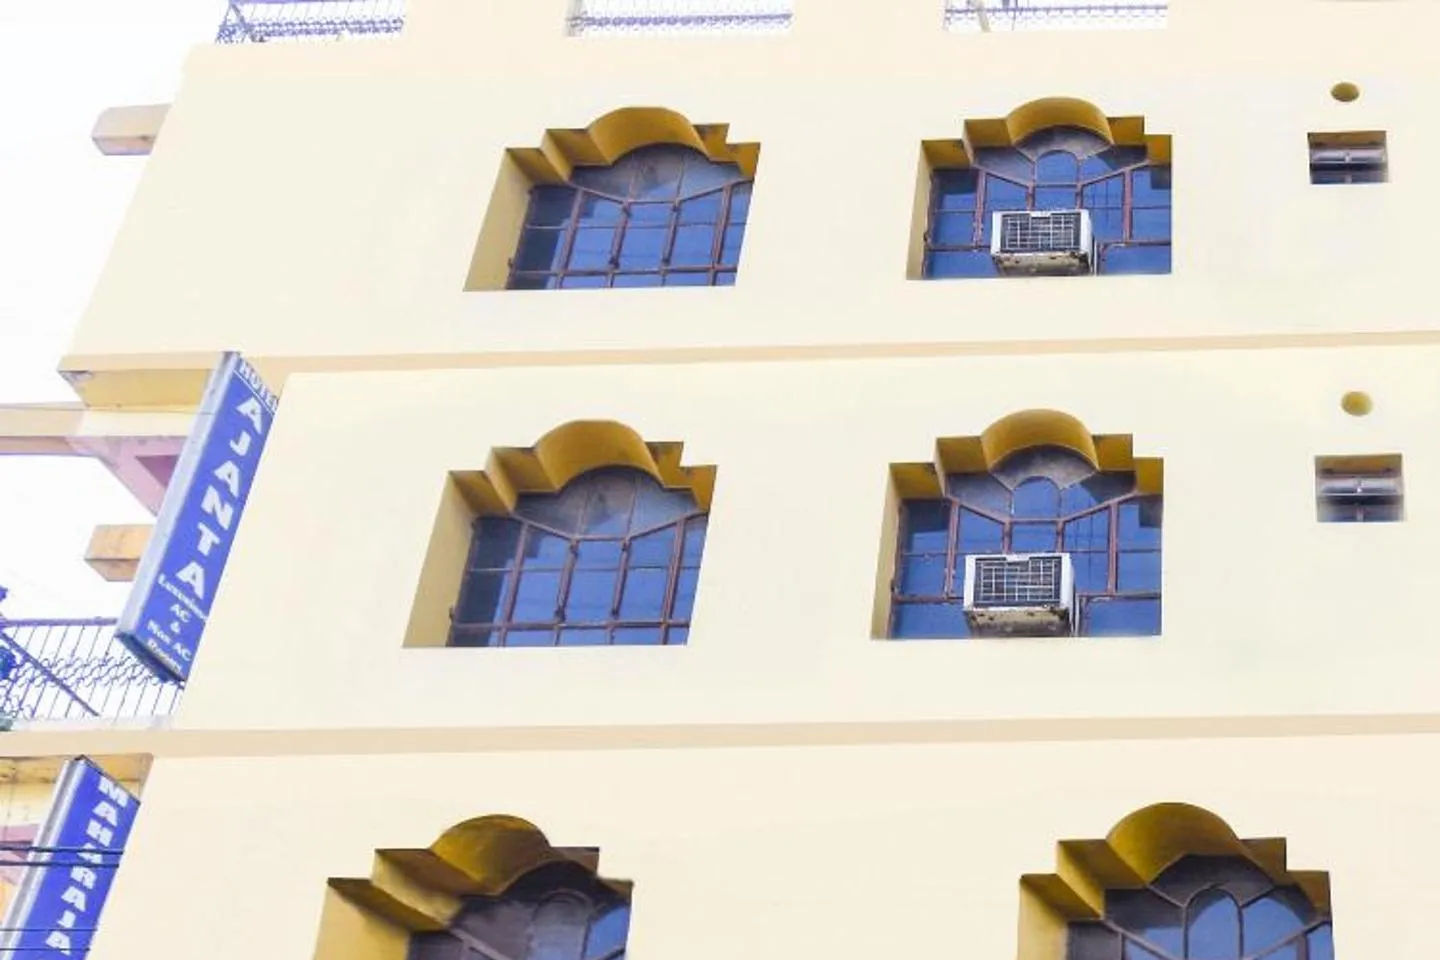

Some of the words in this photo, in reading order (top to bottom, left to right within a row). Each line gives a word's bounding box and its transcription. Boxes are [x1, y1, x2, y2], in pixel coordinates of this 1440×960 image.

[176, 397, 263, 599] AJANTA
[169, 603, 191, 623] AC
[173, 642, 192, 662] AC
[46, 776, 129, 956] MAHARAJA
